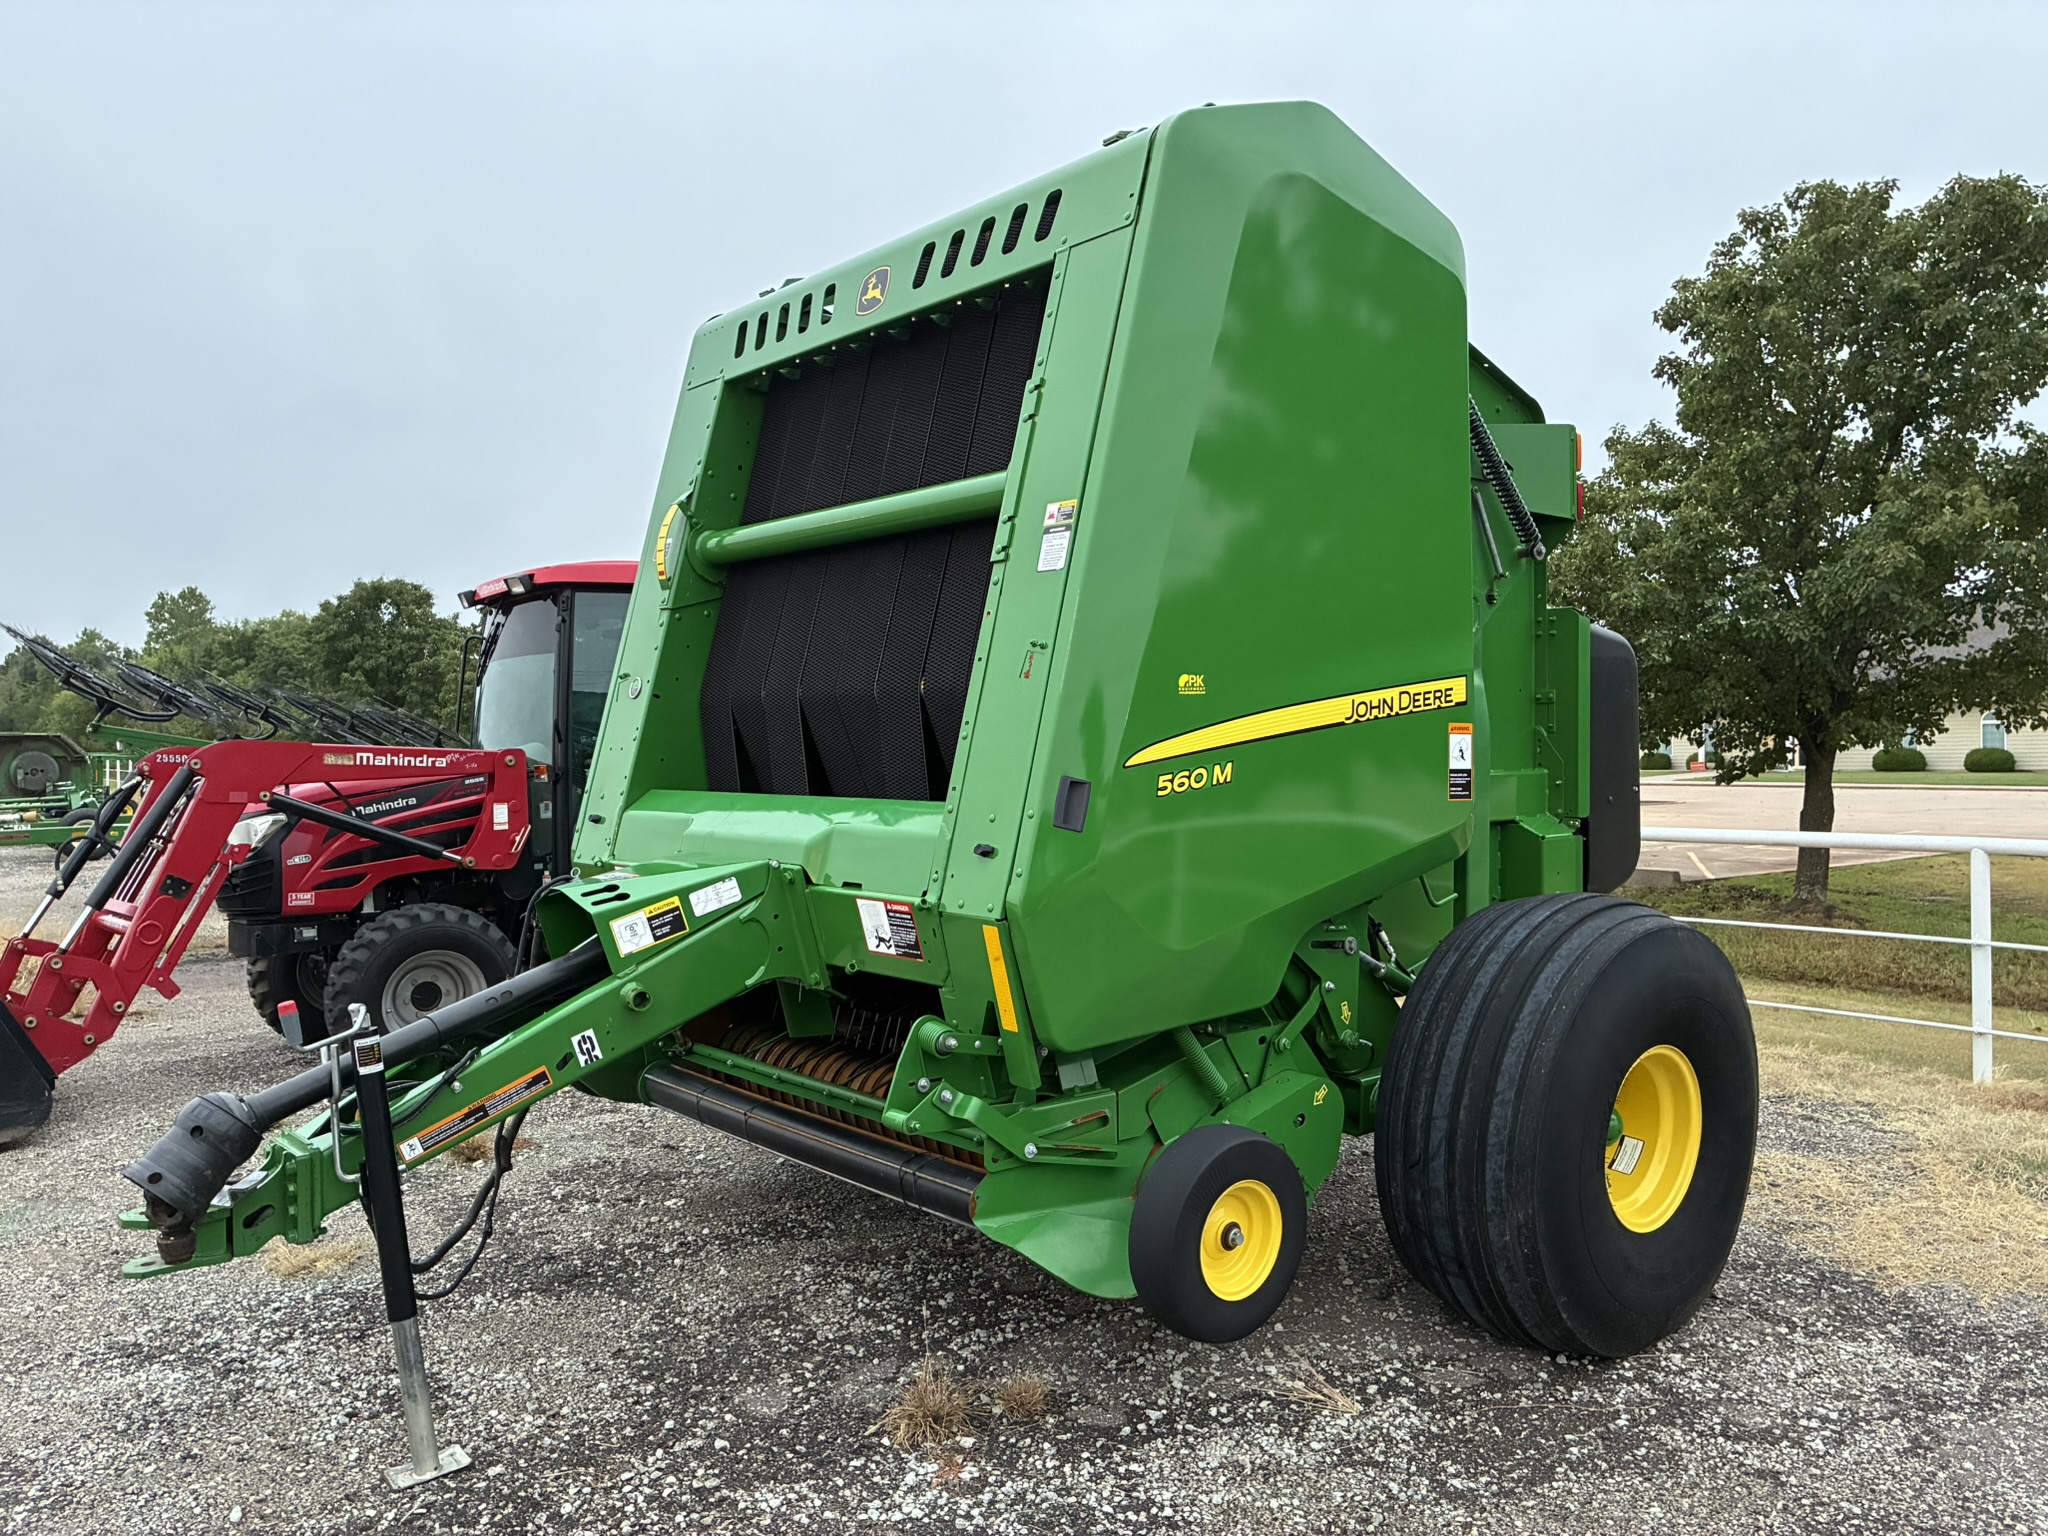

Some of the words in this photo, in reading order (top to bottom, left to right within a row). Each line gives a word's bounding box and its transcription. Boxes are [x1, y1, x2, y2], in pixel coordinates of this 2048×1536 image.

[1344, 696, 1394, 722] JOHN
[1399, 687, 1454, 713] DEERE
[356, 752, 447, 767] Mahindra
[1157, 767, 1208, 798] 560
[1211, 760, 1234, 787] M
[351, 797, 417, 817] Mahindra
[653, 901, 676, 912] CAUTION
